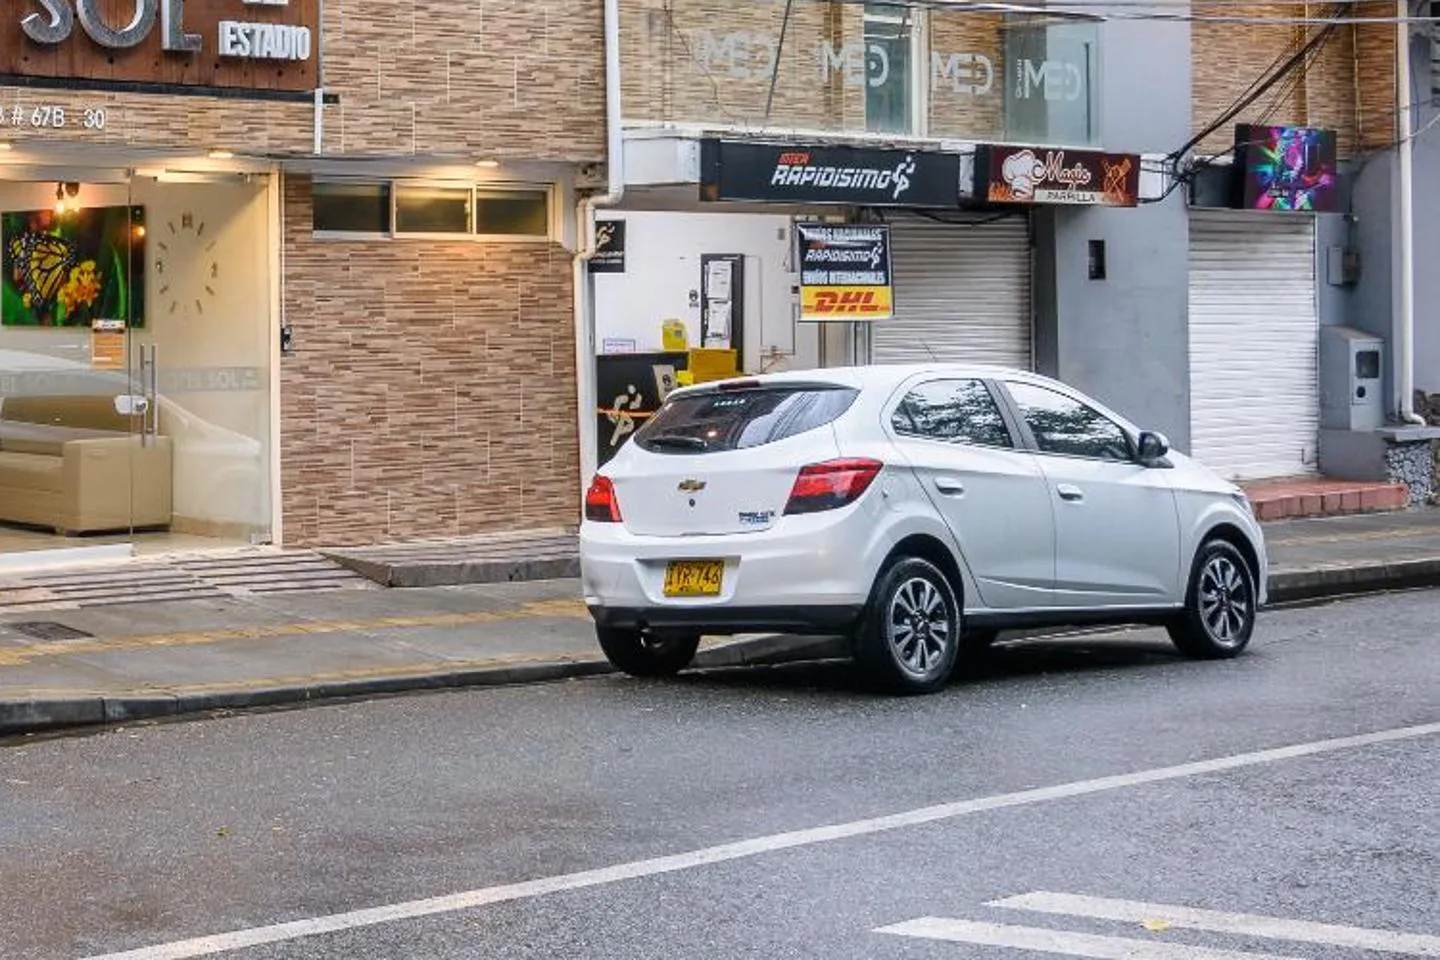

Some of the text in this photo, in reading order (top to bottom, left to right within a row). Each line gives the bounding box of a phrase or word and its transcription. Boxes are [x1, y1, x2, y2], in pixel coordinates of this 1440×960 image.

[218, 20, 311, 60] ESTADIO
[11, 107, 23, 125] #
[31, 106, 65, 128] 67B
[84, 108, 105, 129] 30
[814, 292, 878, 312] DHL
